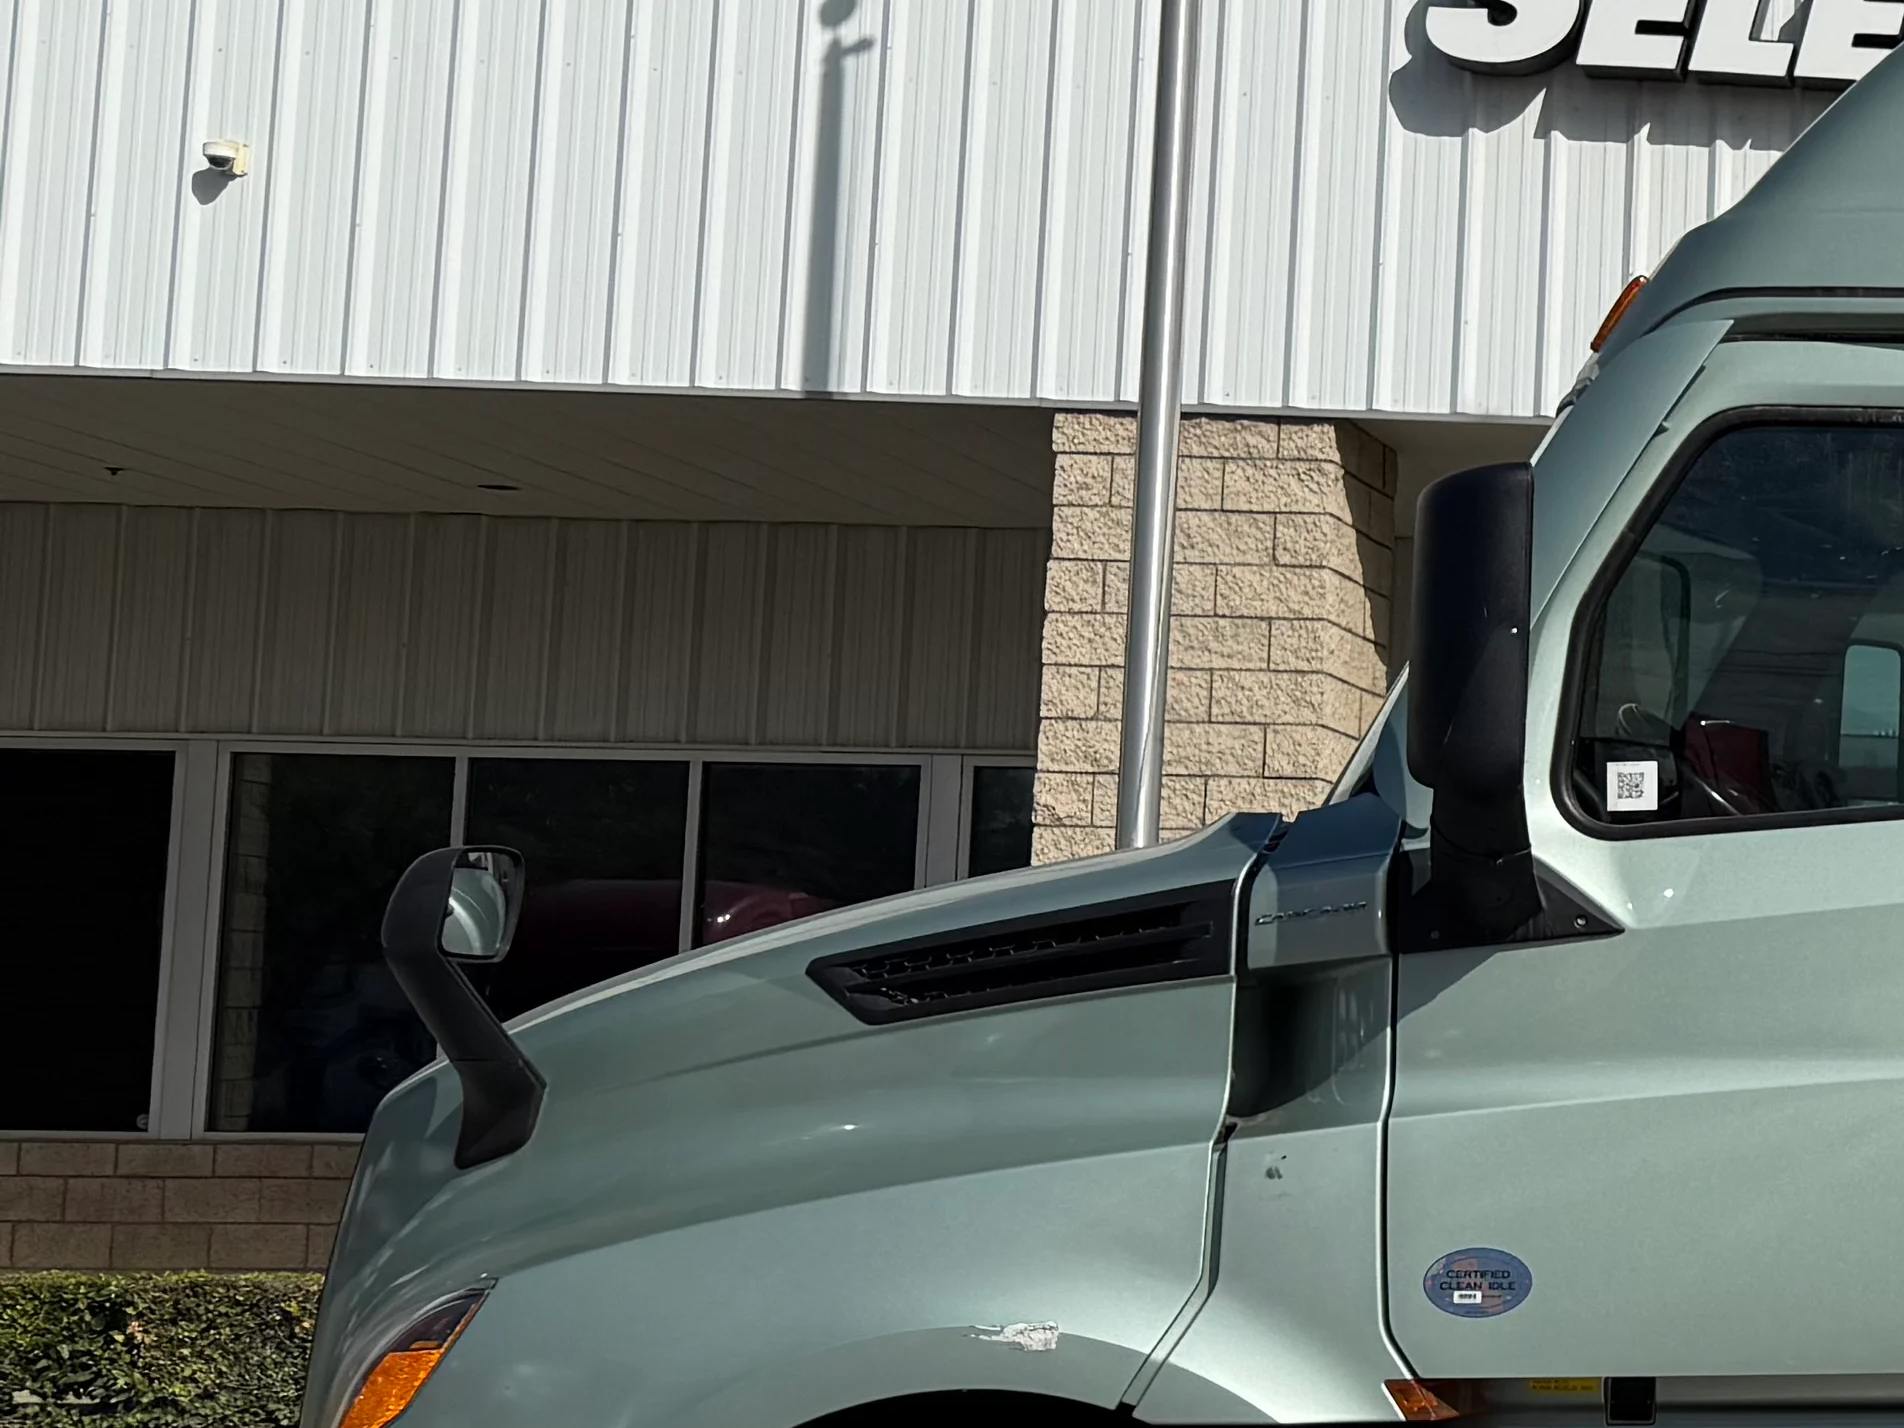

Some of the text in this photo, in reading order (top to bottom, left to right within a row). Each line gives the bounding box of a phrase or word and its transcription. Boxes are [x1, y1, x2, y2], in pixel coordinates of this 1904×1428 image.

[1446, 1269, 1511, 1279] CERTIFIED
[1440, 1281, 1516, 1290] CLEAN IDLE
